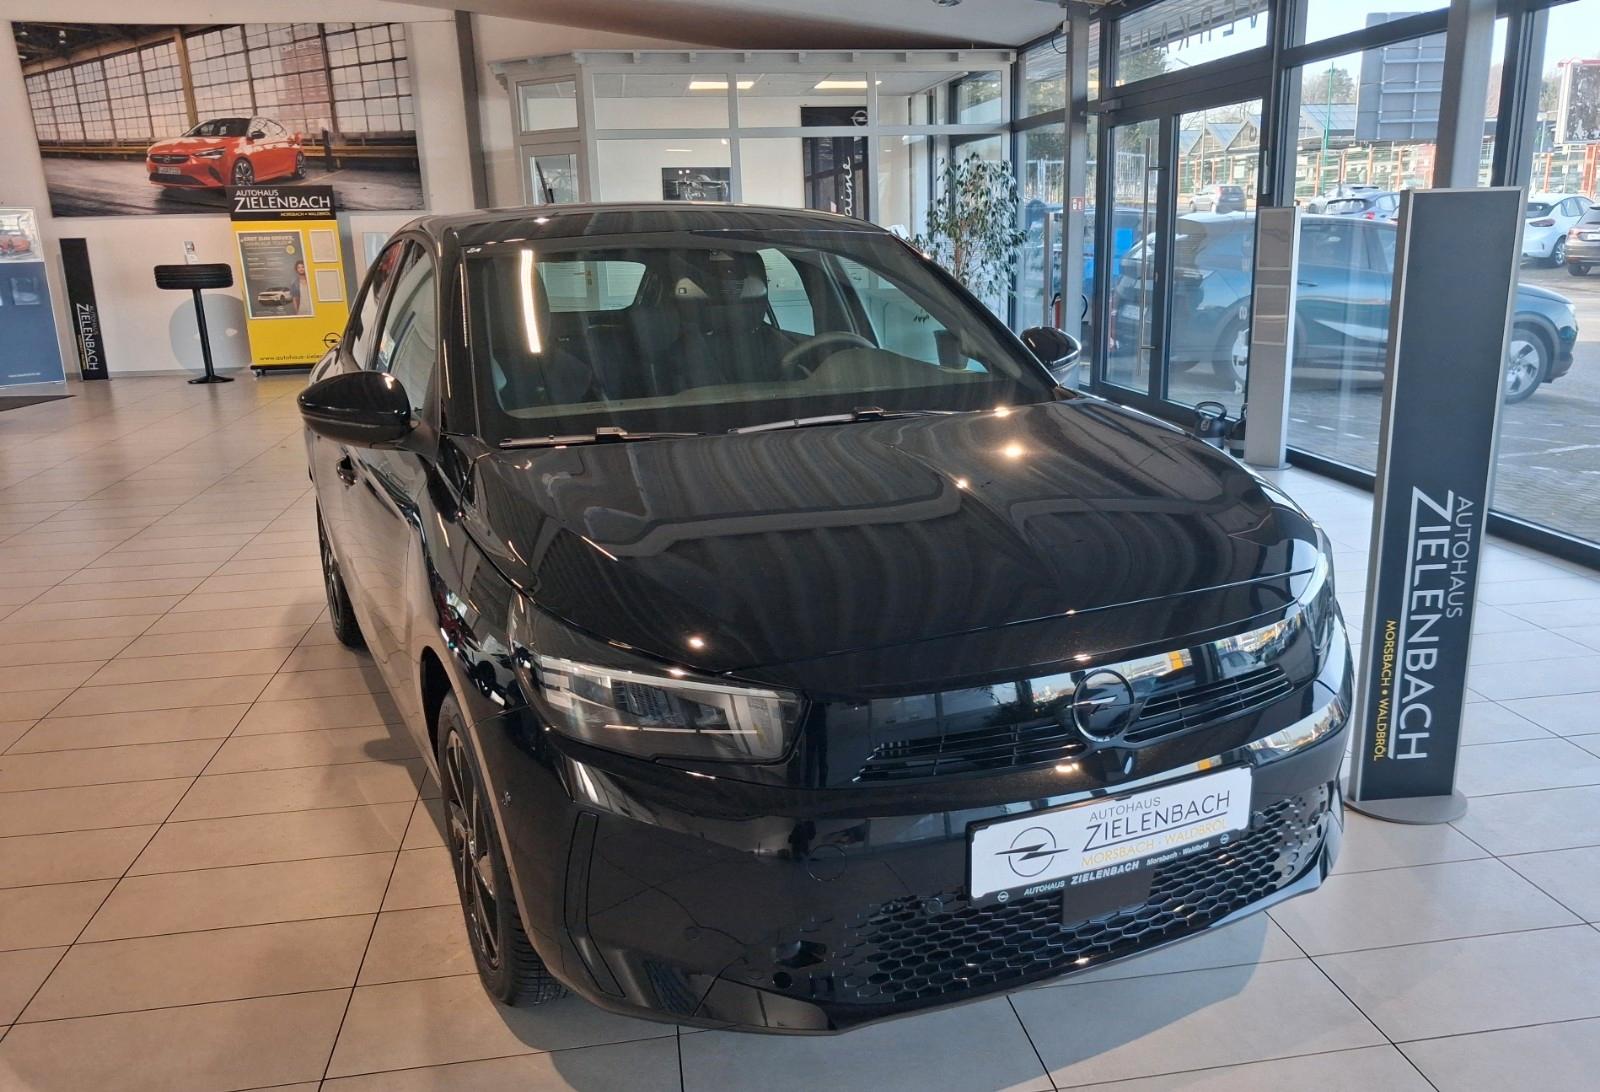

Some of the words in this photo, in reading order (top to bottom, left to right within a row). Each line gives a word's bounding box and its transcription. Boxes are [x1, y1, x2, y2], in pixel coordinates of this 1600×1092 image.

[234, 196, 331, 212] ZIELENBACH
[236, 189, 279, 197] AUTOHAUS
[76, 303, 100, 370] ZIELENBACH
[1446, 495, 1475, 619] AUTOHAUS
[1381, 619, 1398, 688] MORSBACH
[1388, 485, 1455, 760] ZIELENBACH
[1373, 697, 1390, 762] WALDBRÖL
[1081, 789, 1231, 853] ZIELENBACH
[1088, 796, 1162, 823] AUTOHAUS
[1023, 880, 1066, 897] AUTOHAUS
[1070, 859, 1140, 886] ZIELENBACH
[1146, 850, 1178, 866] Morsbach
[1080, 838, 1155, 868] MORSBACH
